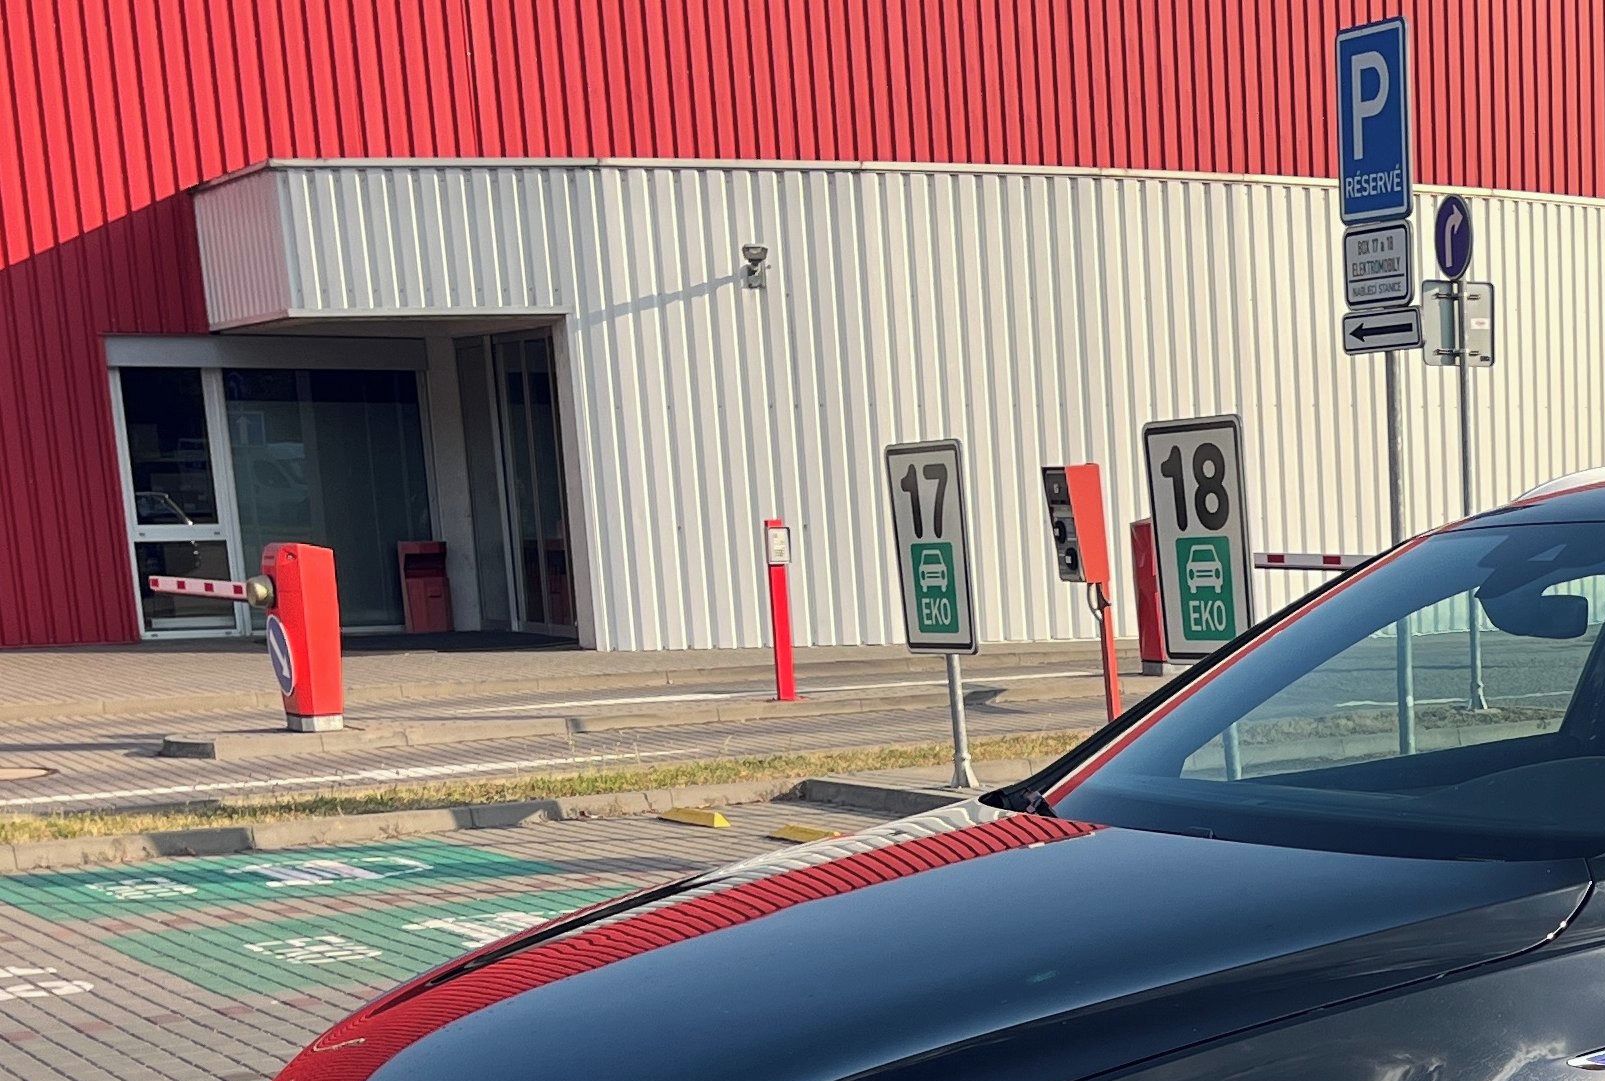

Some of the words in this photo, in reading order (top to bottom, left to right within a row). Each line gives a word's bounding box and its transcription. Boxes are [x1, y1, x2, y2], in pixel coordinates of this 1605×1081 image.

[1351, 51, 1390, 160] P
[1345, 164, 1402, 199] RÉSERVÉ
[900, 463, 948, 539] 17
[1160, 442, 1230, 532] 18
[922, 597, 952, 626] EKO
[1189, 600, 1227, 631] EKO
